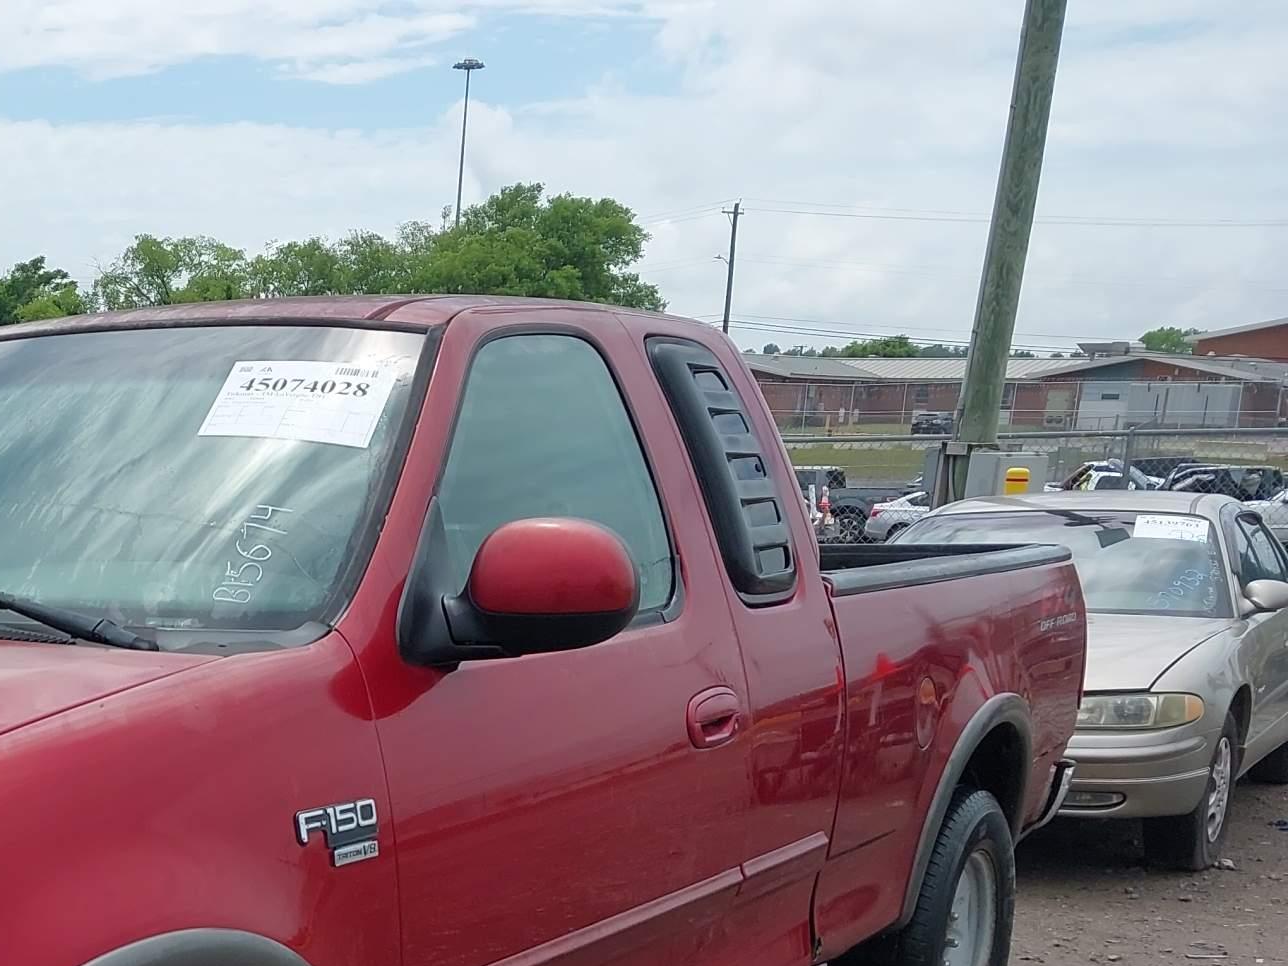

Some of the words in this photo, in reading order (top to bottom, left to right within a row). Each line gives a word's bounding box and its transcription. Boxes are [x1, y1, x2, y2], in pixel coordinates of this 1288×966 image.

[239, 377, 370, 397] 45074028
[336, 848, 363, 862] TRITON
[362, 842, 377, 857] V8
